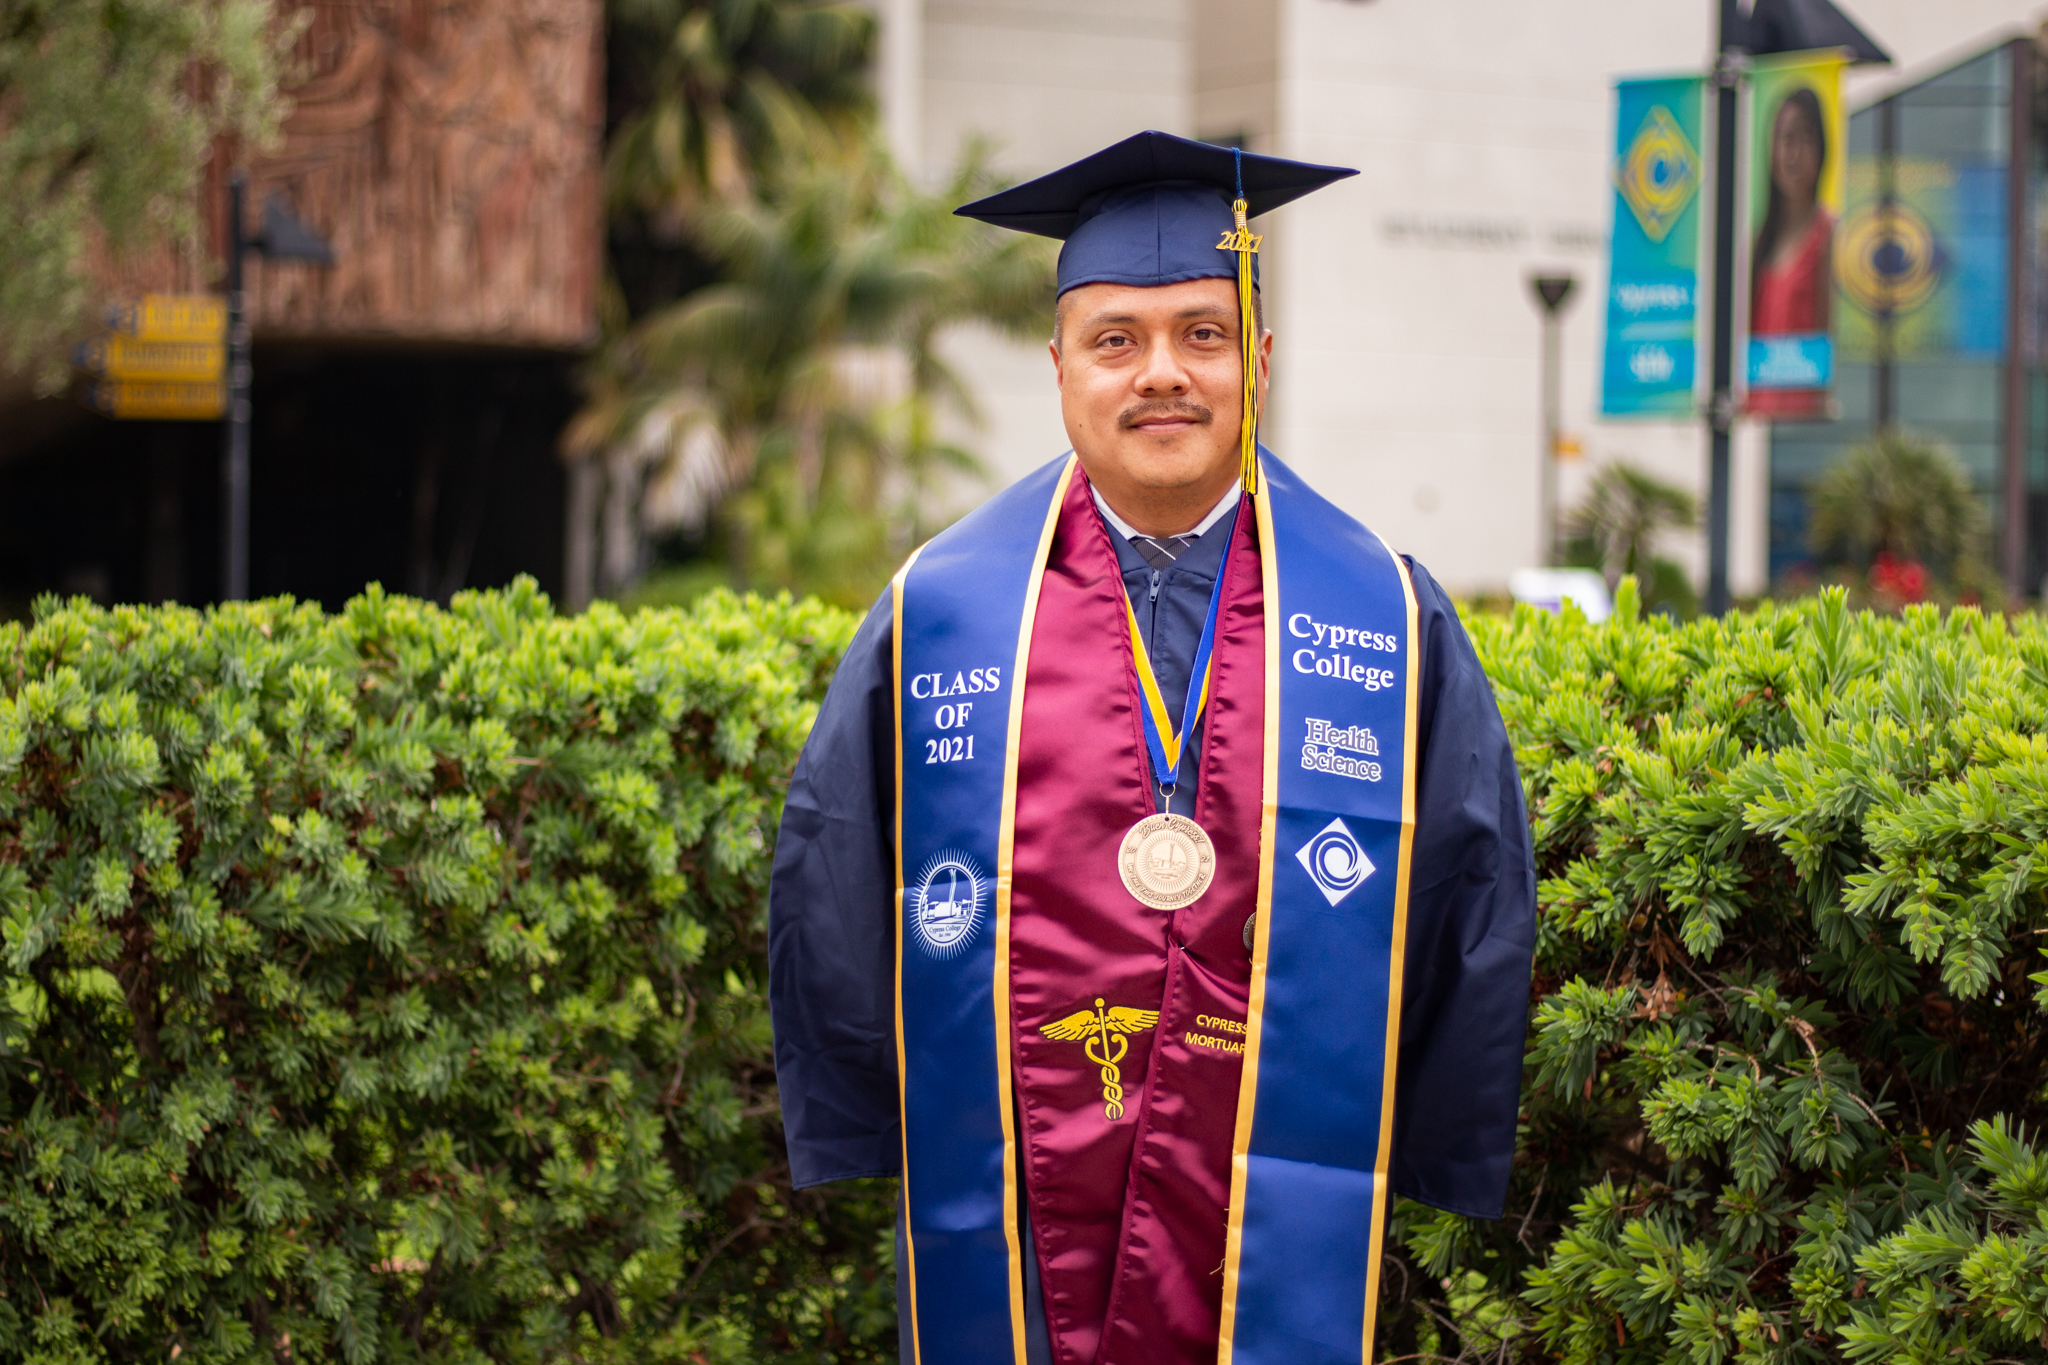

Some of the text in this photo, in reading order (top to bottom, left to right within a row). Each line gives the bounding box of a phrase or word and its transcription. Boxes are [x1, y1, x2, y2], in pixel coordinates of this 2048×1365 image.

[1215, 231, 1264, 253] 2021
[1288, 613, 1397, 653] Cypress
[910, 667, 1000, 699] CLASS
[1292, 648, 1394, 691] College
[935, 702, 973, 730] OF
[925, 734, 975, 765] 2021
[1304, 717, 1379, 756] Health
[1301, 744, 1382, 782] Science
[1139, 821, 1166, 839] Buen
[1196, 1014, 1247, 1035] CYPRESS
